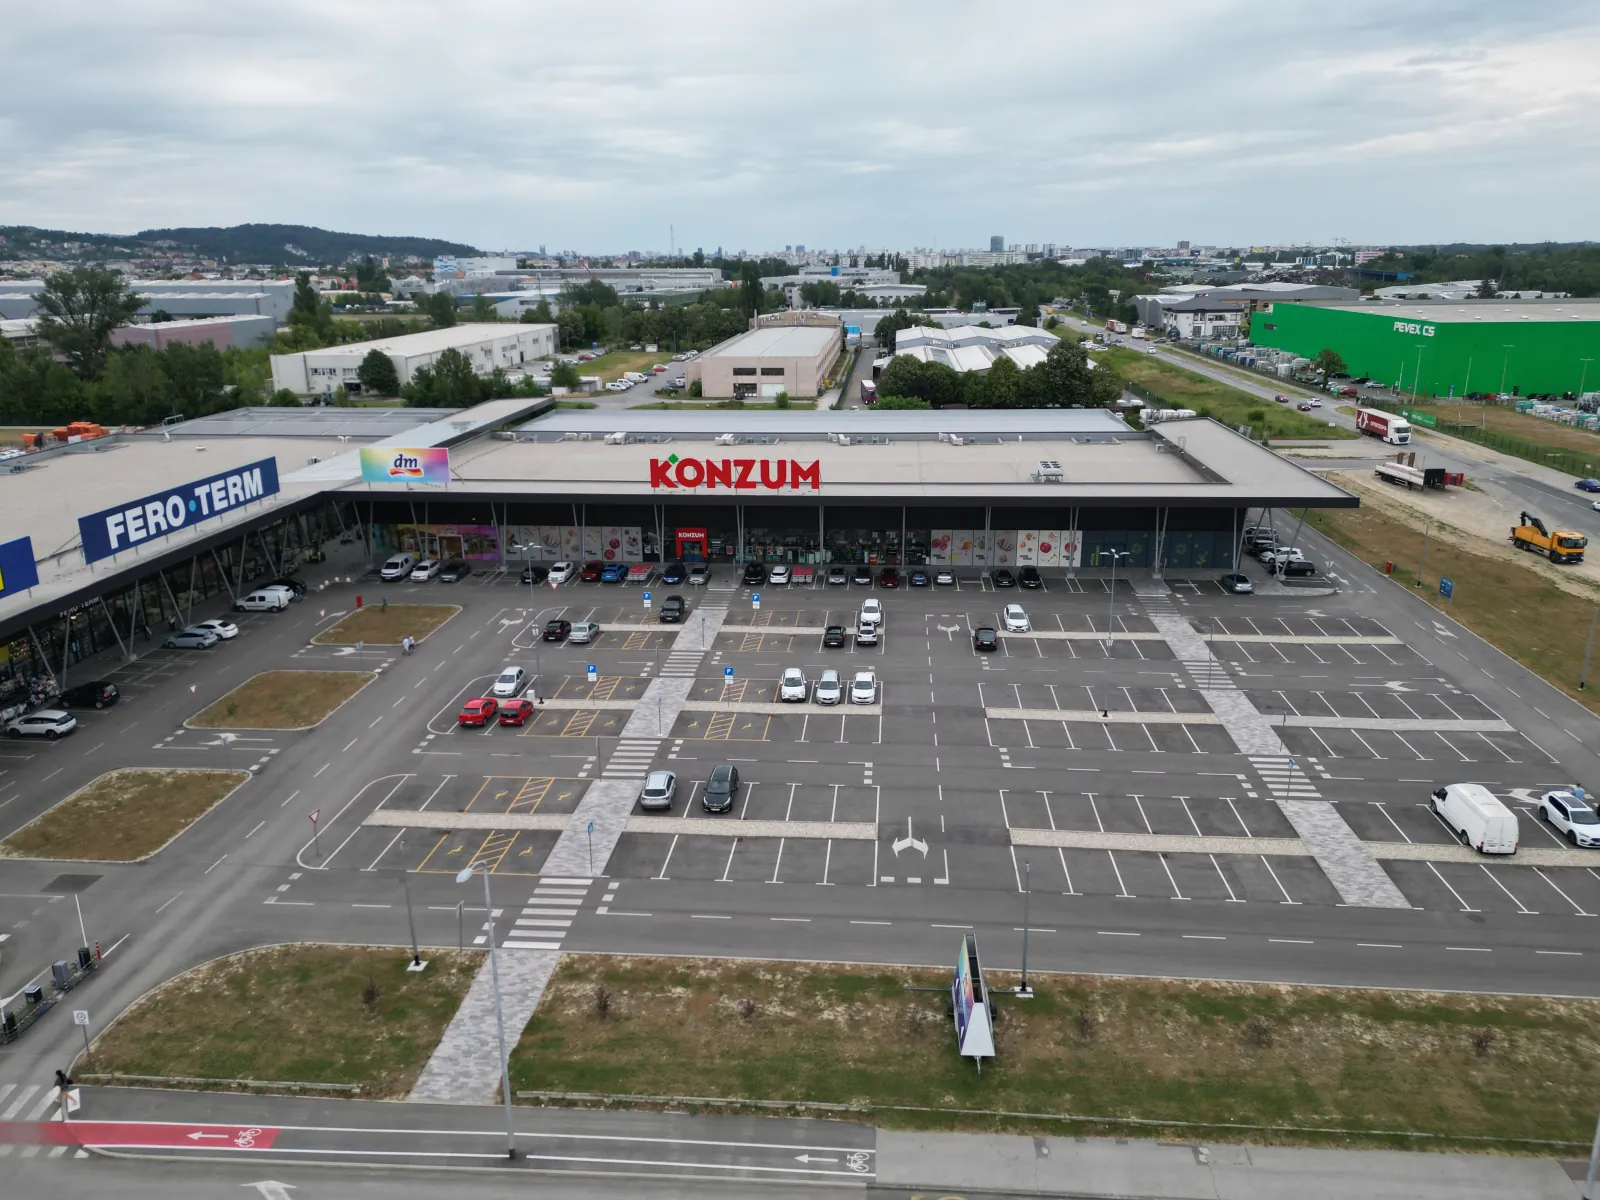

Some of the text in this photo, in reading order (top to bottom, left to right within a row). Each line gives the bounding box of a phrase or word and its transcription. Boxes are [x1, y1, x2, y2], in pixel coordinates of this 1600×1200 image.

[1394, 321, 1435, 337] PEVEX CS
[394, 453, 418, 468] dm
[649, 457, 820, 490] KONZUM
